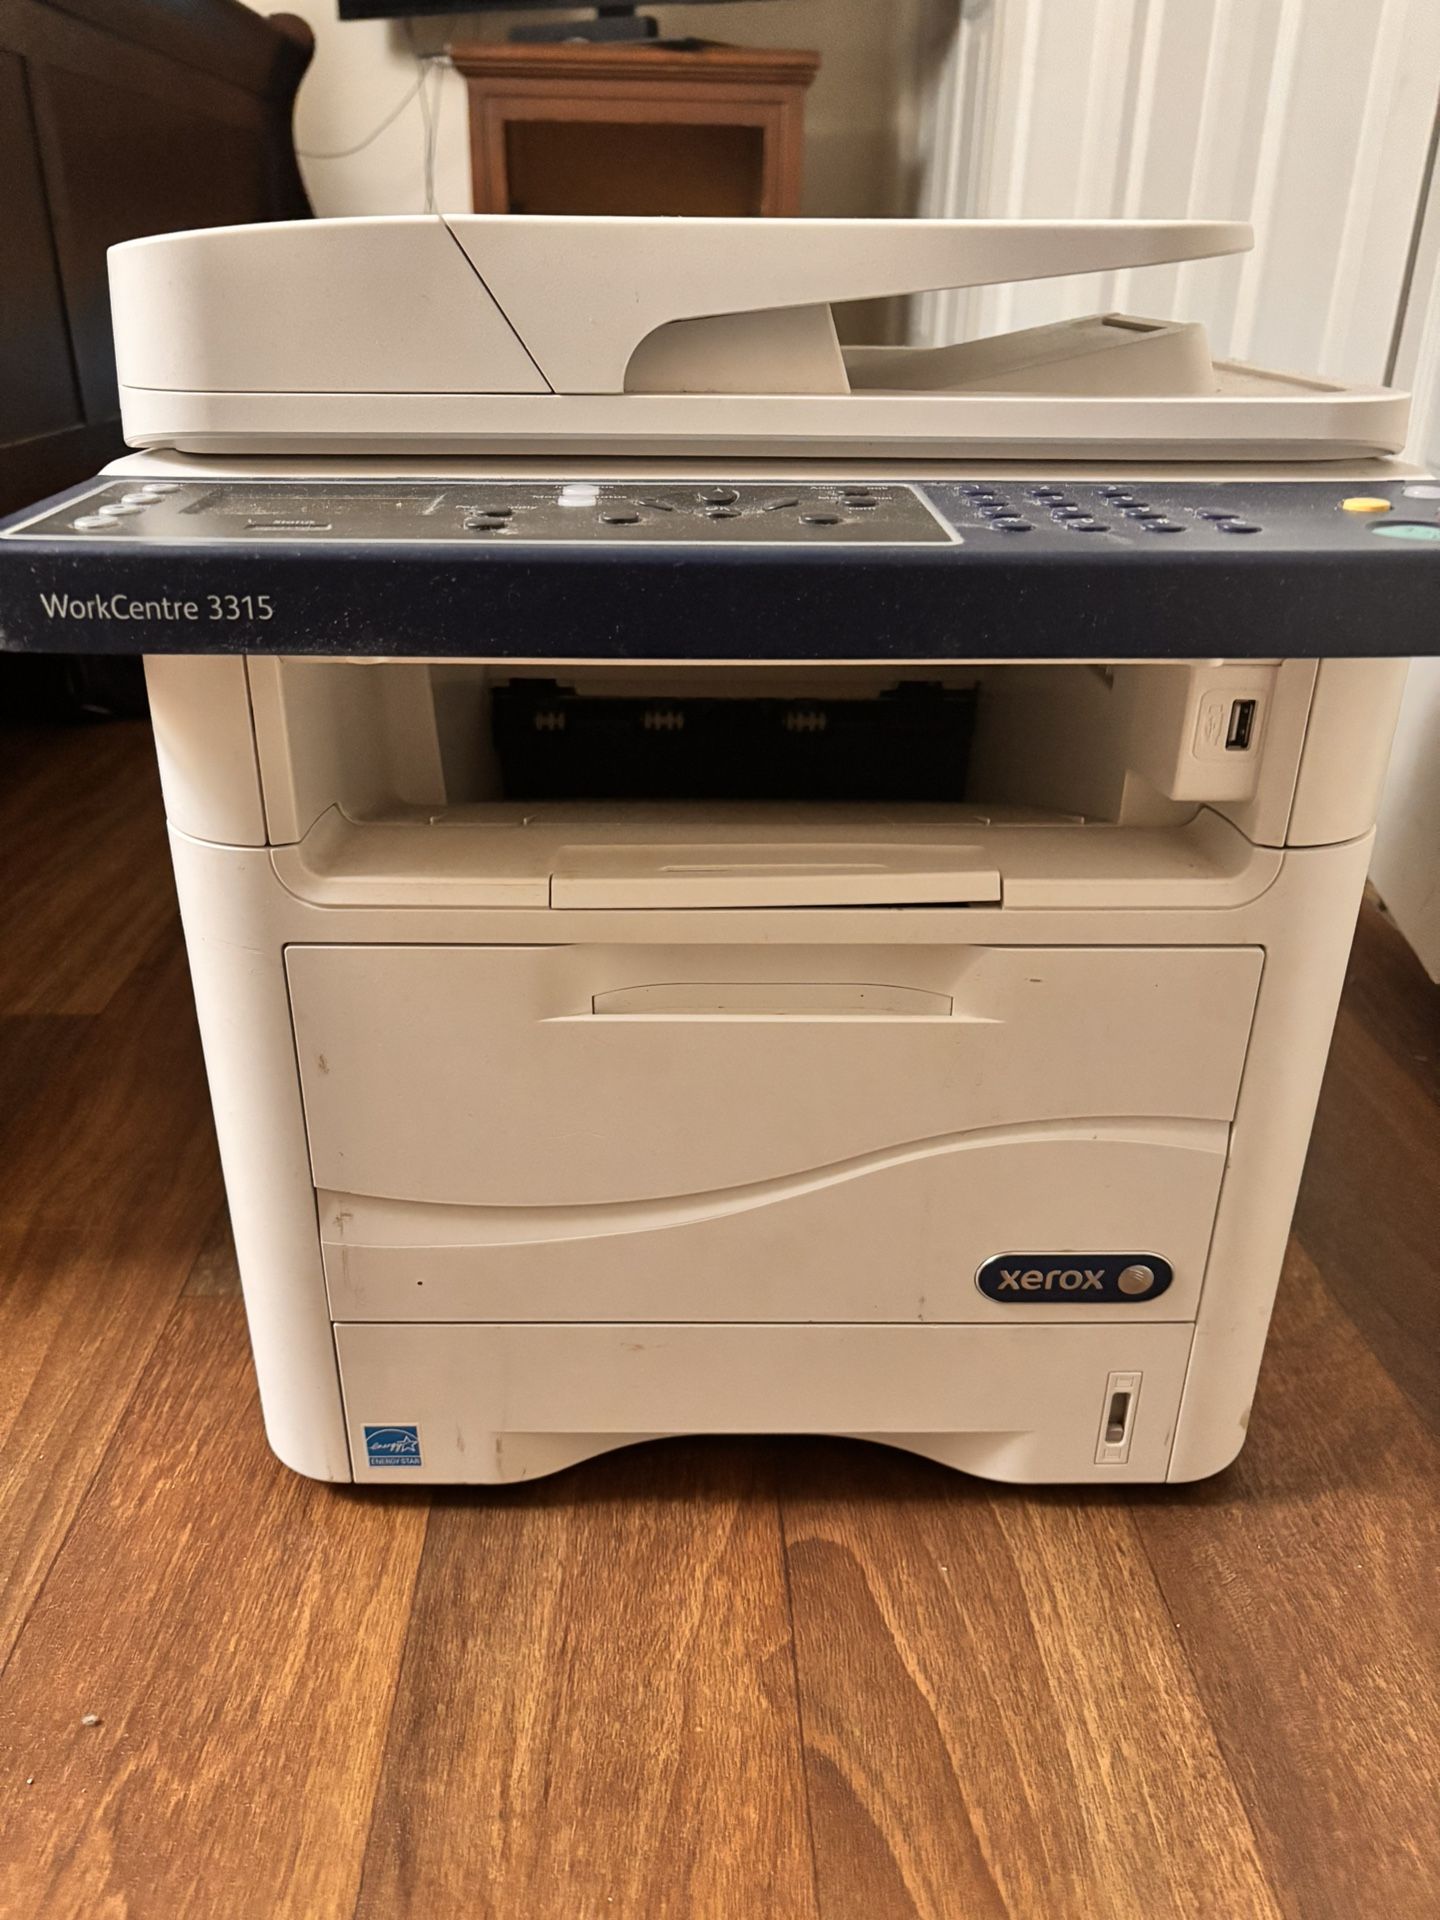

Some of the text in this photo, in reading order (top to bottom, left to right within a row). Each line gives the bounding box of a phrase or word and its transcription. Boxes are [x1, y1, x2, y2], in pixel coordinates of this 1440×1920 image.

[39, 593, 274, 621] WorkCentre 3315
[997, 1269, 1105, 1290] xerox
[370, 1457, 420, 1465] ENERGY STAR
